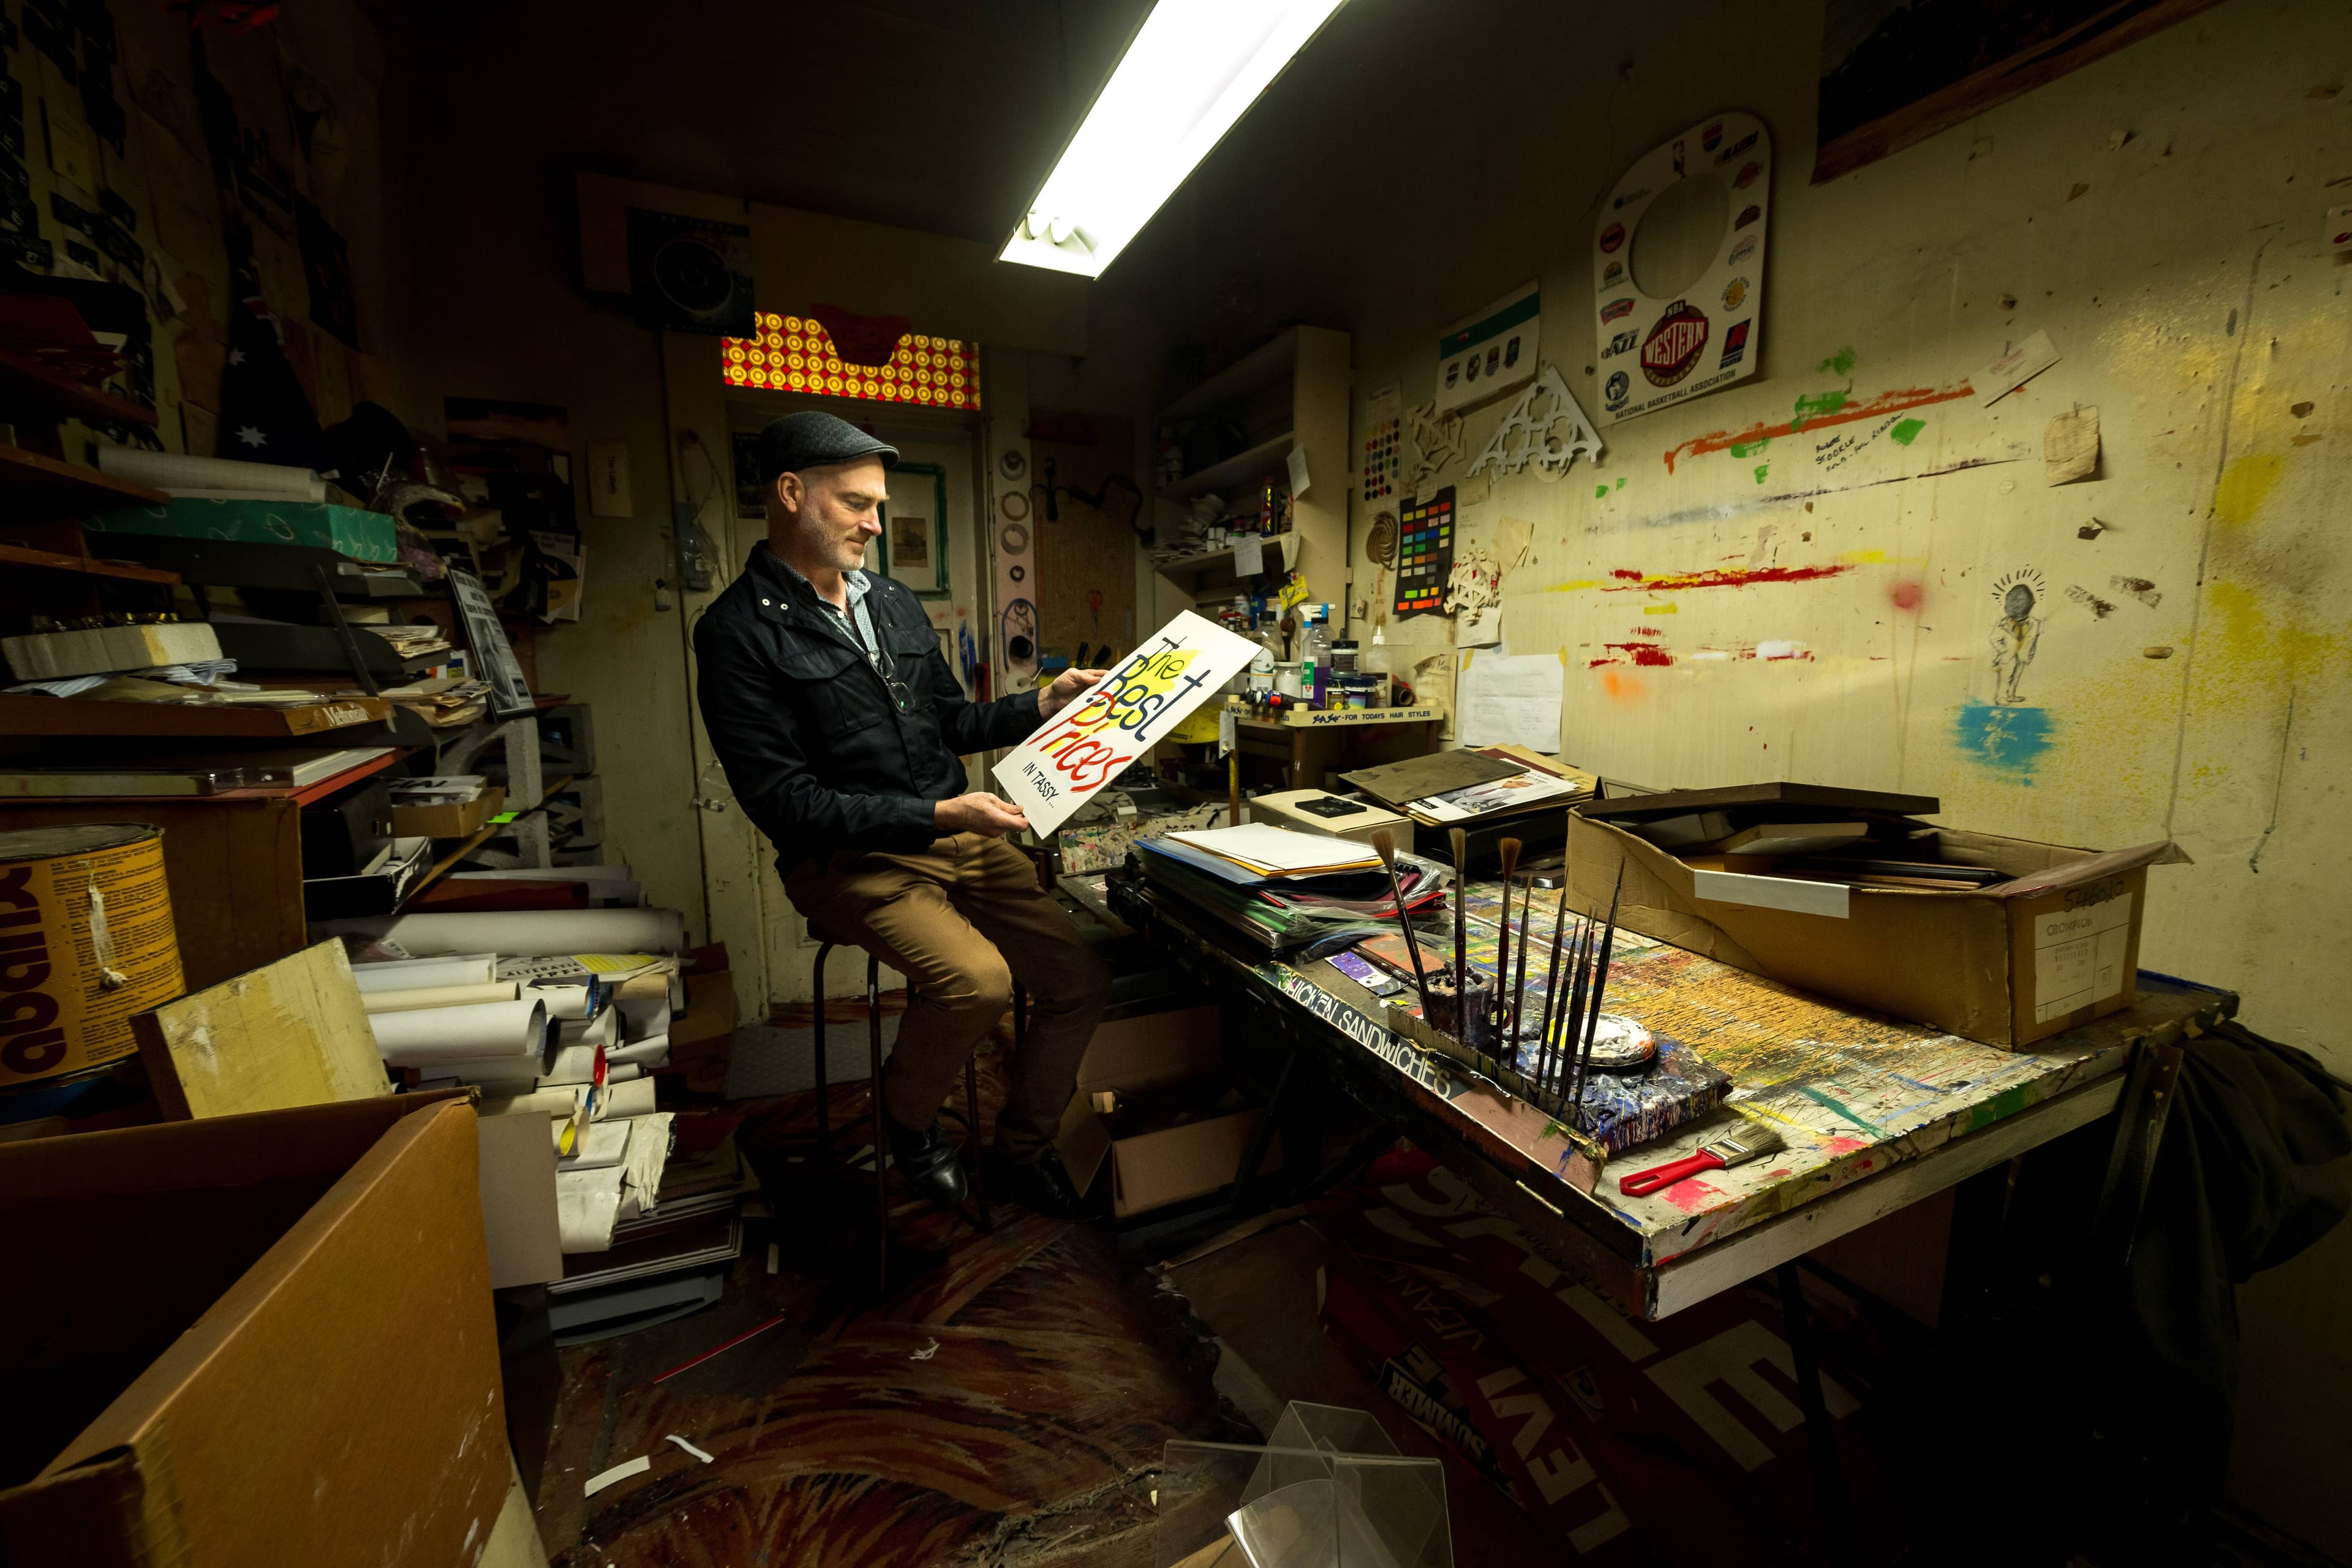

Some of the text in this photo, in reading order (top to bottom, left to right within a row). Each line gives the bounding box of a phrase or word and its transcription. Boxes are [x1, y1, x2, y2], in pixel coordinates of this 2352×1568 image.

[1667, 302, 1684, 317] NBA
[1644, 321, 1706, 366] WESTERN
[1615, 402, 1646, 420] NATIONAL
[1647, 386, 1688, 410] BASKETBALL
[1689, 369, 1736, 394] ASSOCIATION
[1147, 636, 1188, 680] The
[1086, 654, 1211, 742] Best
[1026, 691, 1133, 792] Prices
[1023, 761, 1036, 774] IN
[2046, 917, 2093, 937] CROMPTON
[1277, 977, 1452, 1099] CHICKEN SANDWICHES
[1386, 1370, 1488, 1464] SUMMER
